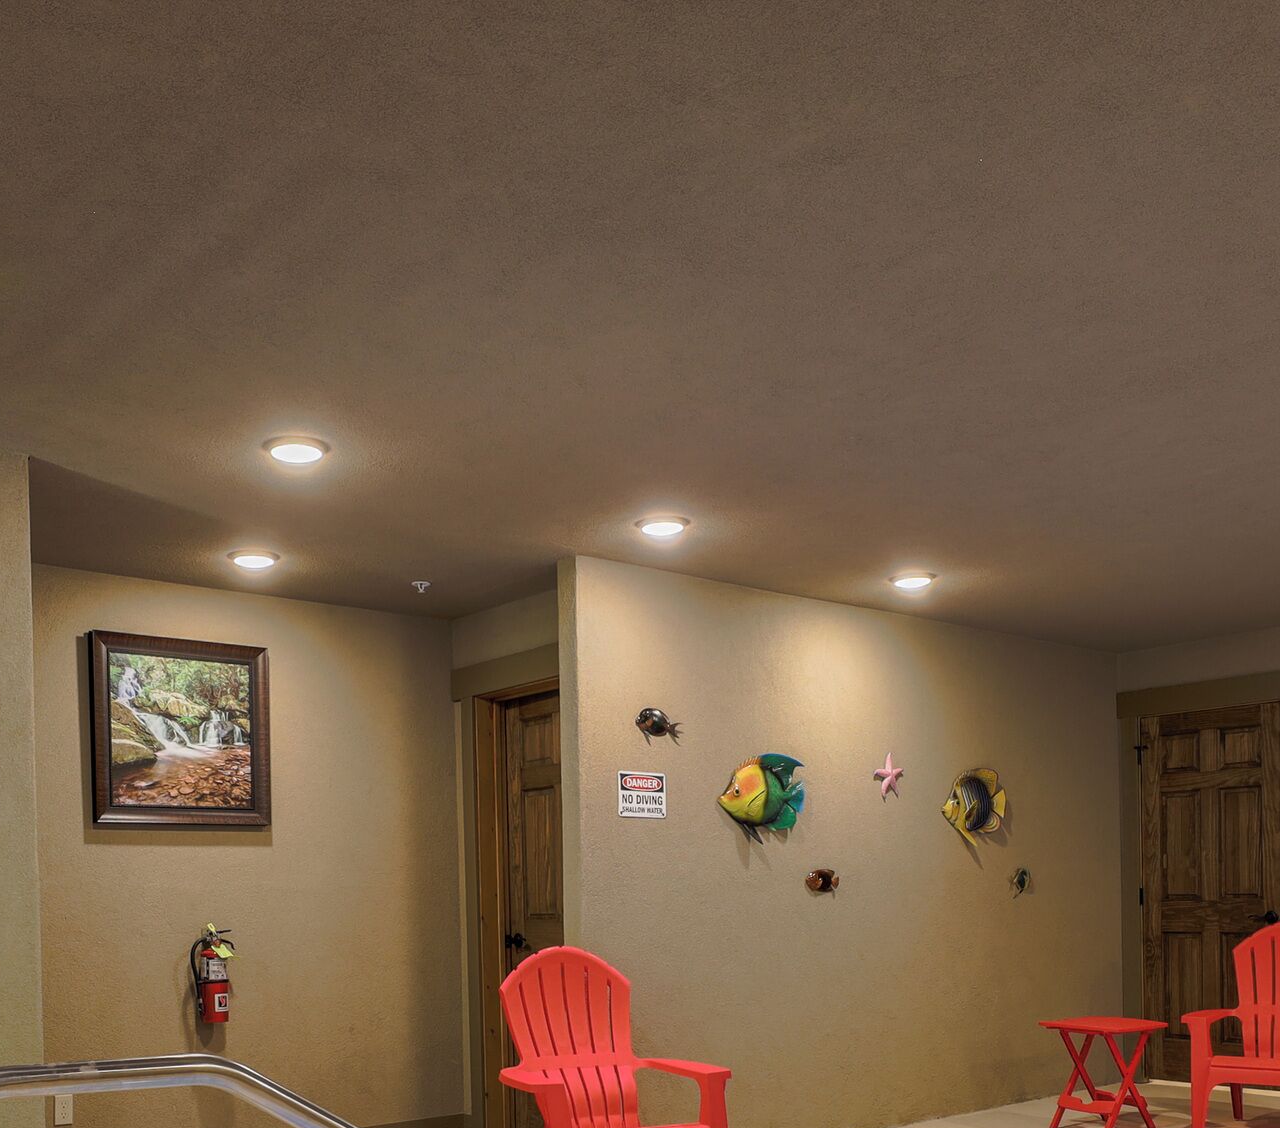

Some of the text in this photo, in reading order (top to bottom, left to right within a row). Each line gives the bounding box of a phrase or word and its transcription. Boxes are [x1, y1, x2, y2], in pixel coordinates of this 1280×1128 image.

[626, 778, 658, 789] DANGER
[622, 794, 663, 806] NO DIVING
